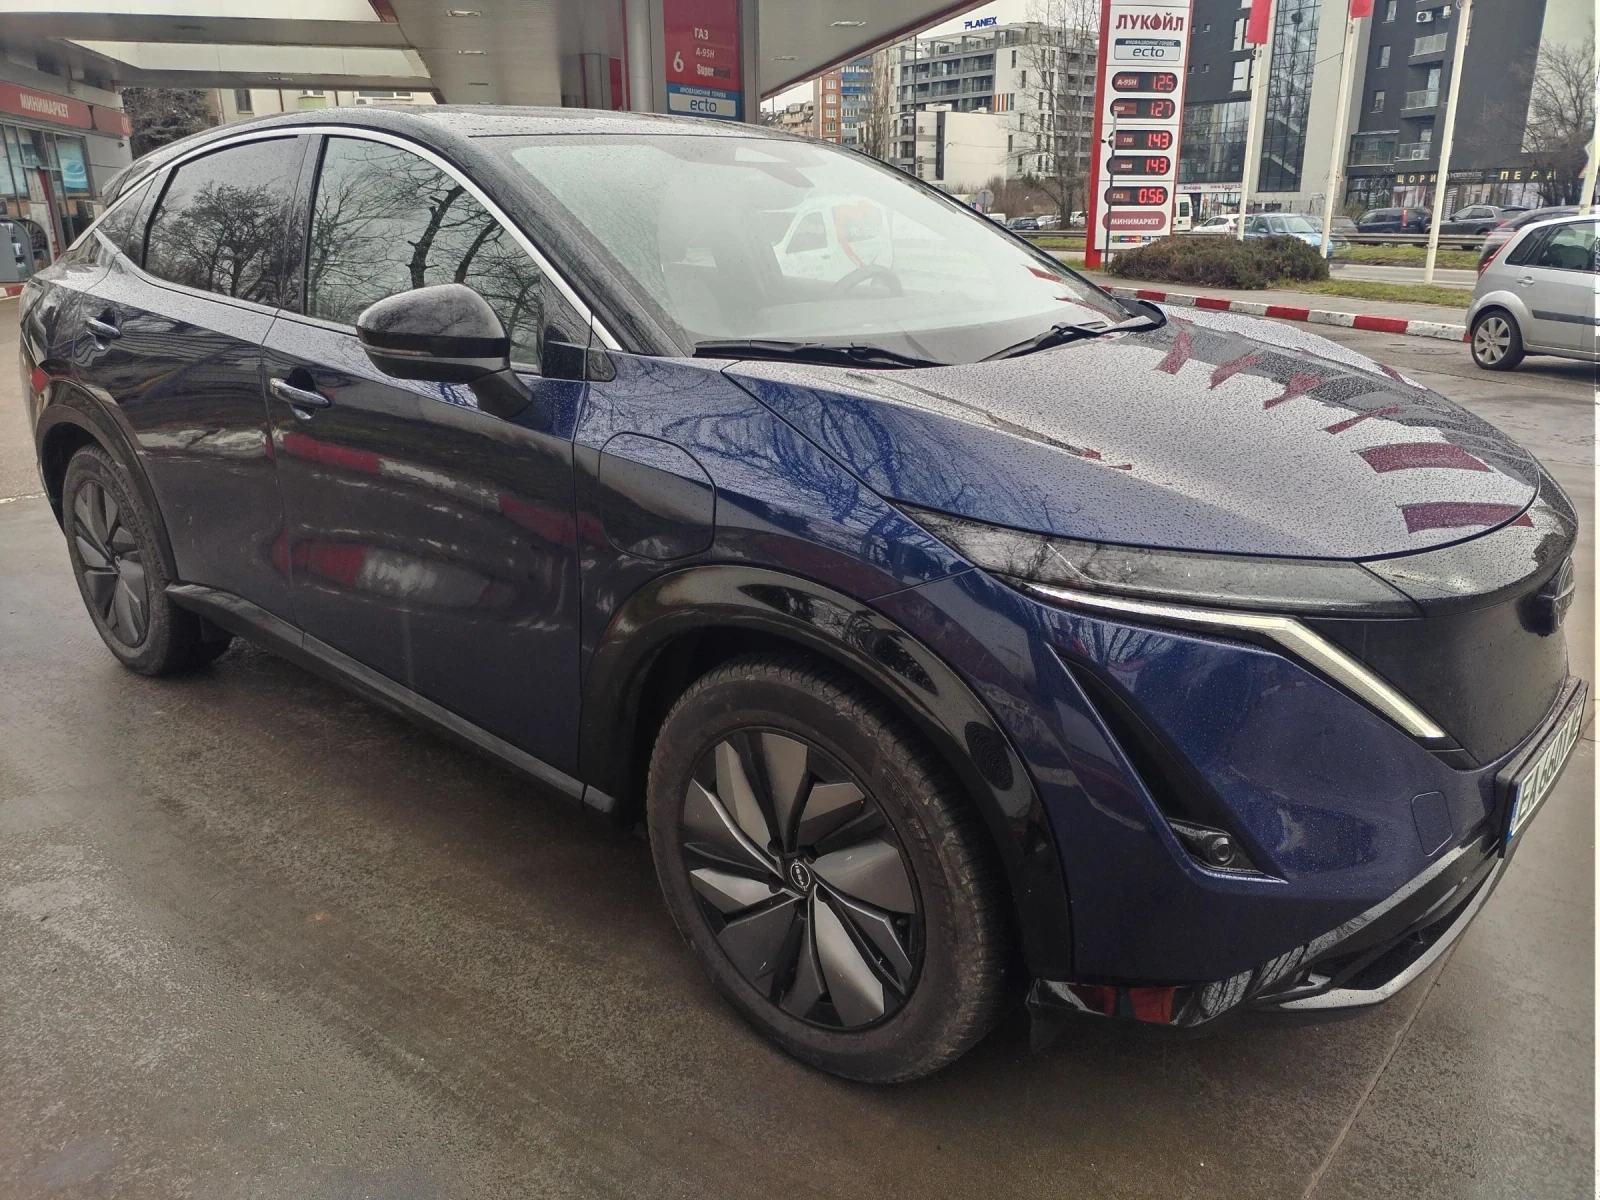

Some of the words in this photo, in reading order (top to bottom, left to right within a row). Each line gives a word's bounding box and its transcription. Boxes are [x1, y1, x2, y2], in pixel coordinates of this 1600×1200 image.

[964, 16, 997, 30] PLANEX
[1115, 12, 1184, 31] ЛУКОЙЛ
[694, 28, 709, 40] ГАЗ
[1132, 46, 1165, 58] ecto
[673, 51, 684, 73] 6
[20, 93, 69, 118] МИНИМАРКЕТ
[690, 98, 717, 113] ecto
[1396, 174, 1437, 184] ЩОРИ
